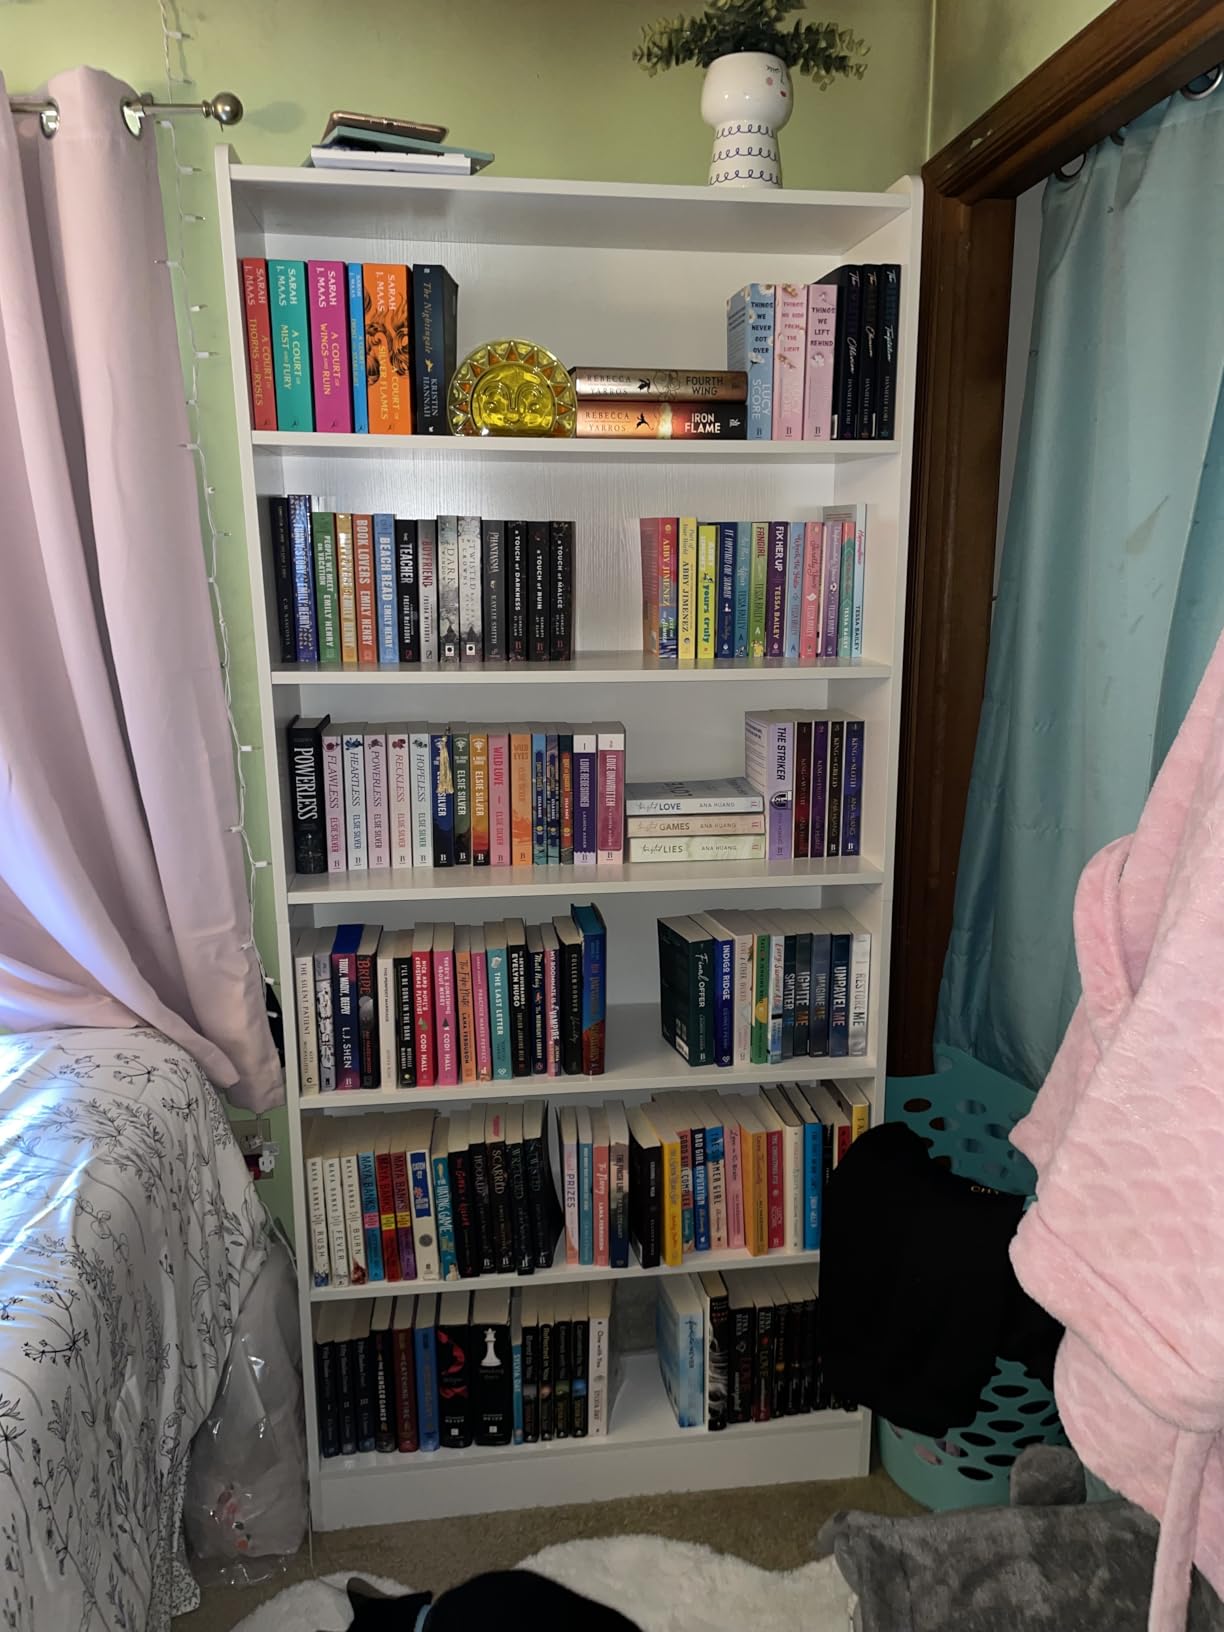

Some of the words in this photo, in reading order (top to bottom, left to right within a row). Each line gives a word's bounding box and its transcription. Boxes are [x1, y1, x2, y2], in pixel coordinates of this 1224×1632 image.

[246, 275, 256, 306] MAAS
[256, 268, 266, 304] SARAH
[278, 276, 287, 306] MAAS
[288, 268, 298, 304] SARAH
[318, 277, 327, 308] MAAS
[328, 270, 336, 306] SARAH
[377, 281, 386, 312] MAAS
[388, 274, 396, 310] SARAH
[250, 319, 260, 359] THORNS
[280, 324, 289, 349] MIST
[320, 323, 329, 356] WINGS
[420, 302, 432, 354] Nightingale
[292, 340, 302, 376] COURT
[332, 343, 341, 379] COURT
[254, 373, 263, 406] ROSES
[283, 363, 292, 389] FURY
[322, 371, 331, 396] RUIN
[686, 376, 724, 386] FOURTH
[380, 377, 388, 420] FLAMES
[430, 378, 438, 416] KRISTIN
[692, 387, 718, 396] WING
[752, 378, 762, 419] SCORE
[762, 384, 770, 416] LUCY
[588, 424, 626, 432] YARROS
[684, 423, 720, 433] FLAME
[692, 413, 714, 422] IRON
[356, 520, 368, 546] BOOK
[756, 526, 766, 558] FANGIRL
[380, 537, 391, 571] BEACH
[422, 540, 432, 587] BOYFRIEND
[662, 538, 672, 564] ABBY
[775, 542, 784, 558] HER
[358, 548, 370, 584] LOVERS
[400, 544, 414, 584] TEACHER
[446, 548, 456, 585] DARK
[774, 560, 783, 572] UP
[382, 574, 393, 600] READ
[663, 566, 672, 606] JIMENEZ
[702, 584, 710, 612] yours
[774, 586, 782, 610] TESSA
[324, 594, 332, 619] EMILY
[360, 590, 371, 616] EMILY
[384, 604, 392, 624] EMILY
[324, 621, 334, 647] HENRY
[362, 619, 372, 646] HENRY
[702, 617, 710, 643] truly
[776, 728, 786, 743] THE
[494, 746, 503, 766] WILD
[606, 755, 616, 770] LOVE
[776, 744, 786, 782] STRIKER
[294, 747, 318, 820] POWERLESS
[328, 754, 338, 809] FLAWLESS
[350, 752, 360, 806] HEARTLESS
[372, 751, 382, 807] POWERLESS
[396, 754, 405, 802] RECKLESS
[416, 754, 426, 802] HOPELESS
[458, 770, 466, 790] ELSIE
[476, 771, 484, 790] ELSIE
[494, 768, 504, 786] LOVE
[438, 792, 446, 816] SILVER
[458, 791, 466, 816] SILVER
[476, 792, 484, 816] SILVER
[659, 802, 681, 810] LOVE
[418, 812, 426, 828] ELSIE
[660, 822, 690, 831] GAMES
[663, 845, 684, 854] LIES
[358, 958, 371, 994] BRIDE
[494, 973, 502, 986] THE
[722, 976, 730, 1000] RIDGE
[796, 971, 810, 1006] IGNITE
[816, 973, 826, 1006] IMAGINE
[833, 966, 847, 1010] UNRAVEL
[494, 989, 503, 1007] LAST
[698, 982, 706, 1008] OFFER
[784, 972, 795, 1010] SHATTER
[854, 973, 866, 1010] RESTORE
[496, 1010, 504, 1036] LETTER
[832, 1012, 845, 1027] ME
[852, 1010, 866, 1026] ME
[343, 1043, 352, 1068] SHEN
[361, 1156, 372, 1180] MAYA
[696, 1150, 704, 1165] GIRL
[362, 1182, 376, 1212] BANKS
[566, 1173, 576, 1208] PRIZES
[696, 1166, 706, 1205] REPUTATION
[438, 1211, 454, 1233] GAME
[316, 1230, 326, 1257] RUSH
[336, 1230, 344, 1260] FEVER
[353, 1228, 362, 1255] BURN
